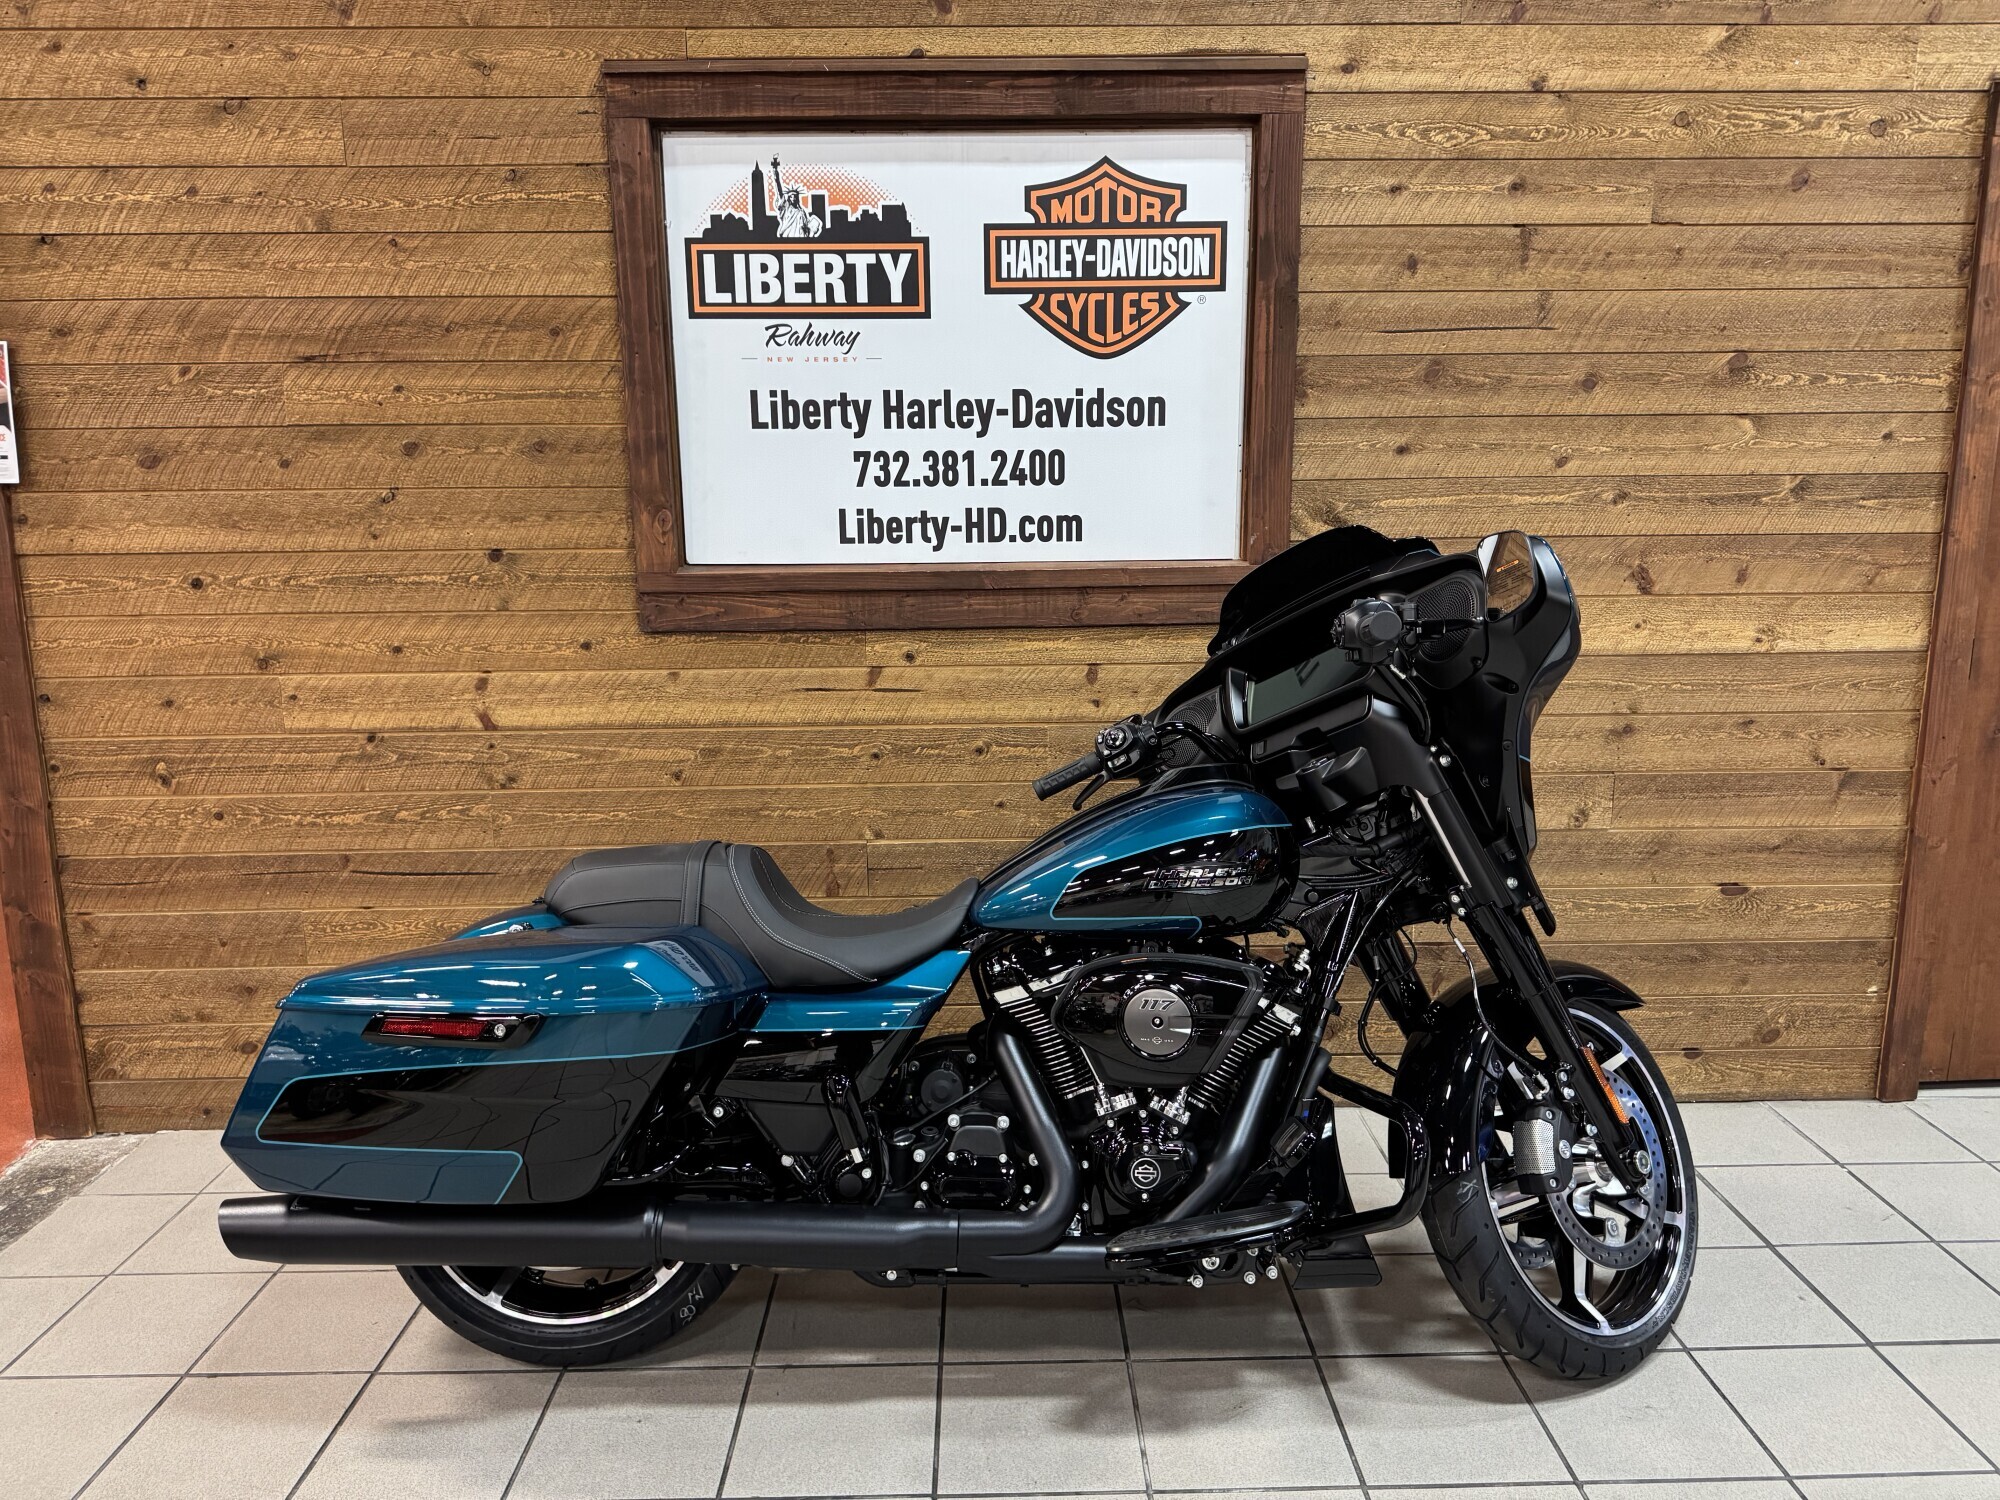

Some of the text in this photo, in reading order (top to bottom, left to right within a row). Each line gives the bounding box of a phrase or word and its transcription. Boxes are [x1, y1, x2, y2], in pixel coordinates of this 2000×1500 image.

[1050, 177, 1162, 224] MOTOR
[702, 252, 912, 304] LIBERTY
[1000, 236, 1211, 279] HARLEY-DAVIDSON
[764, 321, 861, 355] Rahway
[1049, 291, 1160, 344] CYCLES
[749, 387, 1167, 439] Liberty Harley-Davidson
[853, 448, 1066, 488] 732.381.2400
[838, 507, 1084, 553] Liberty-HD.com
[1139, 998, 1178, 1011] 117
